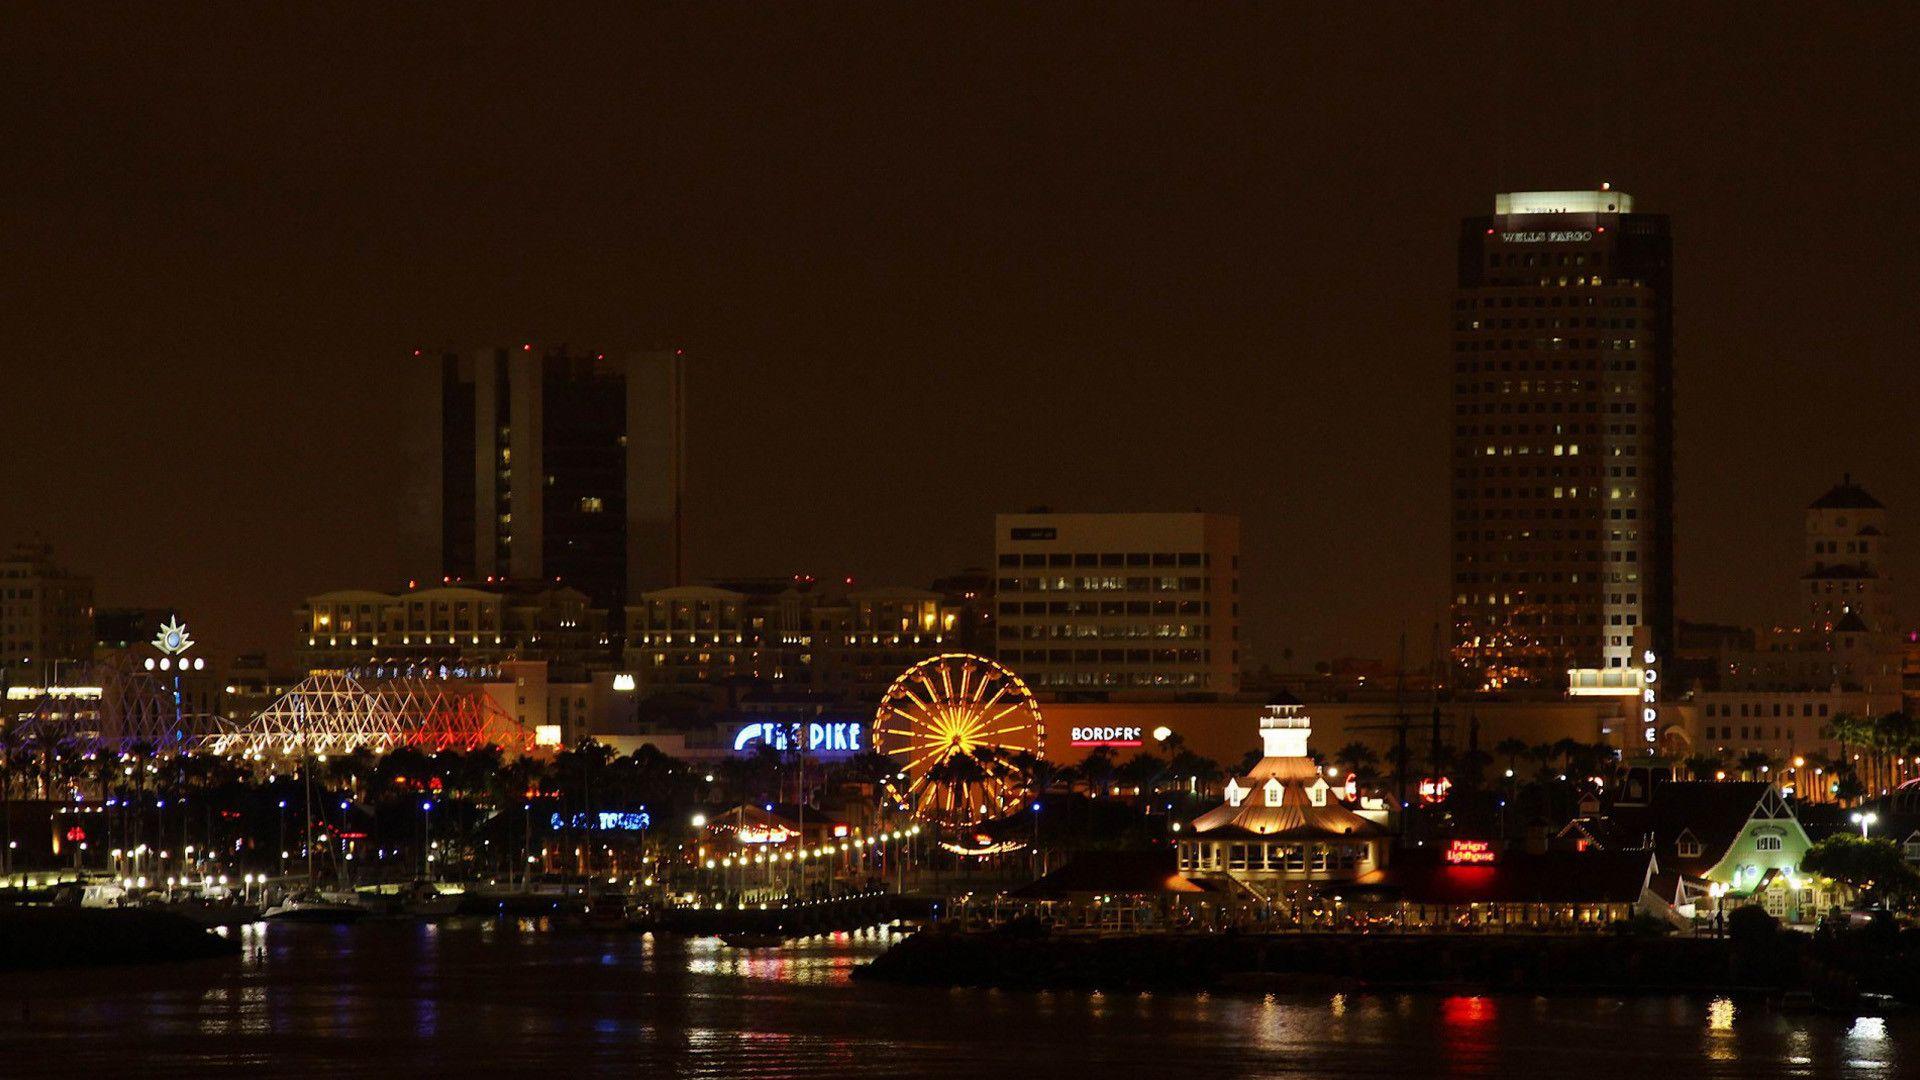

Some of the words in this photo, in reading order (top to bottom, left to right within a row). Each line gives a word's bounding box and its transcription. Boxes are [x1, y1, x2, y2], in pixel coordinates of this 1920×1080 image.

[1547, 231, 1592, 242] FARGO
[809, 723, 860, 750] PIKE
[1072, 727, 1141, 741] BORDERS
